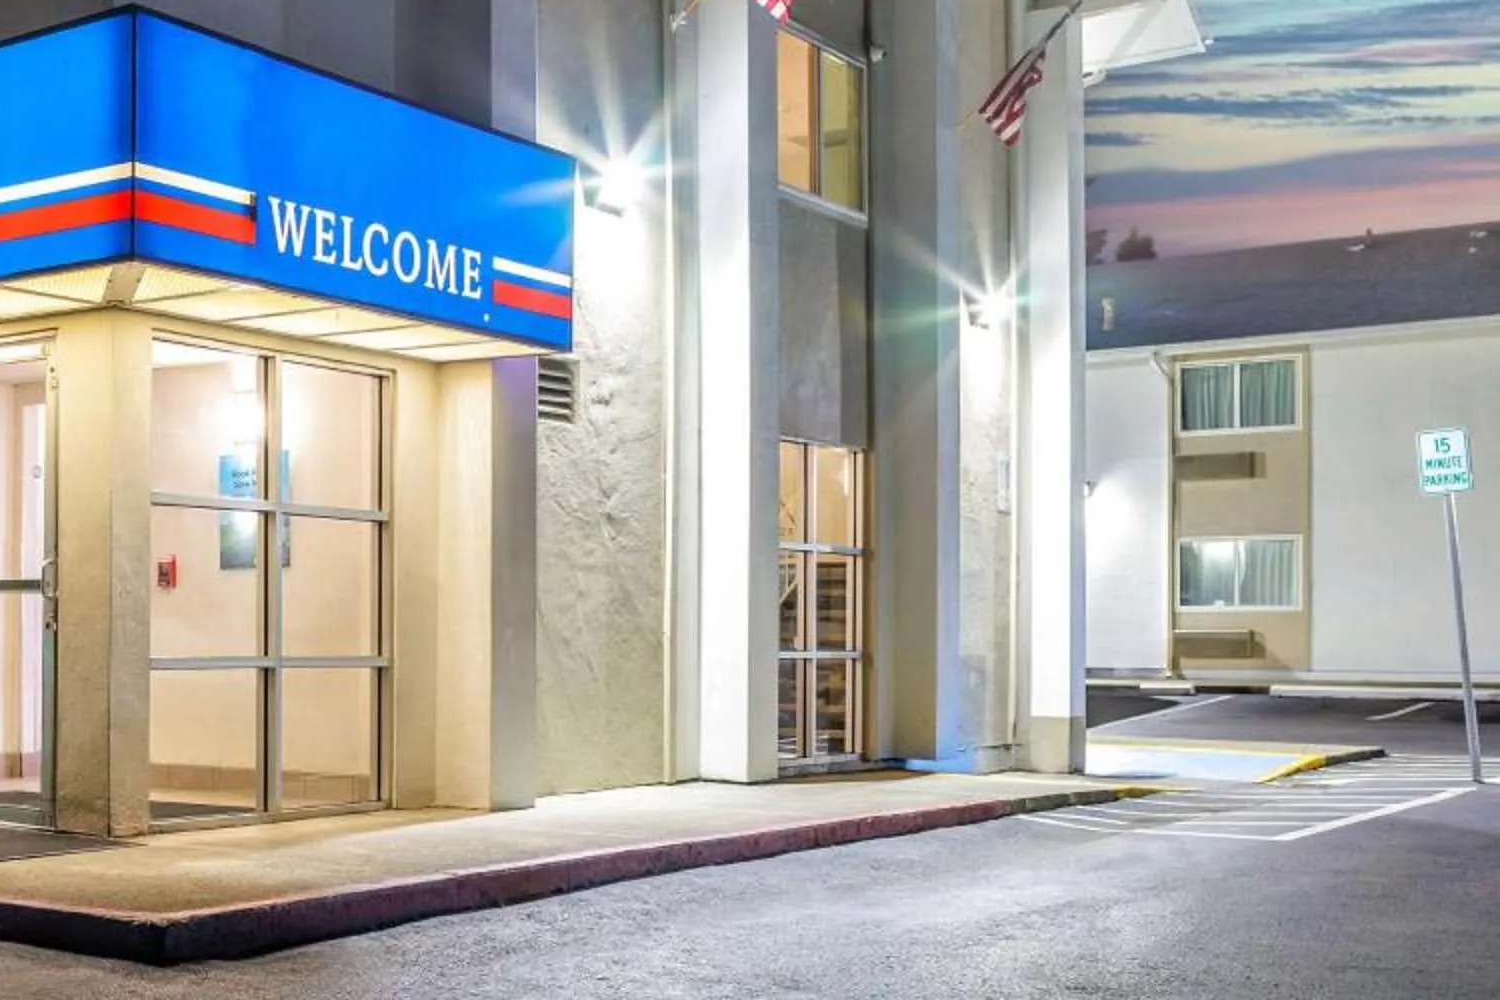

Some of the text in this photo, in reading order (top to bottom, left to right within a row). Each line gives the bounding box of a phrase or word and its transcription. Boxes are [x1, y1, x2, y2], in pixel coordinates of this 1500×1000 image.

[267, 196, 483, 301] WELCOME
[1435, 438, 1451, 453] 15
[1426, 456, 1463, 471] MINUTE
[1423, 472, 1467, 487] PARKING
